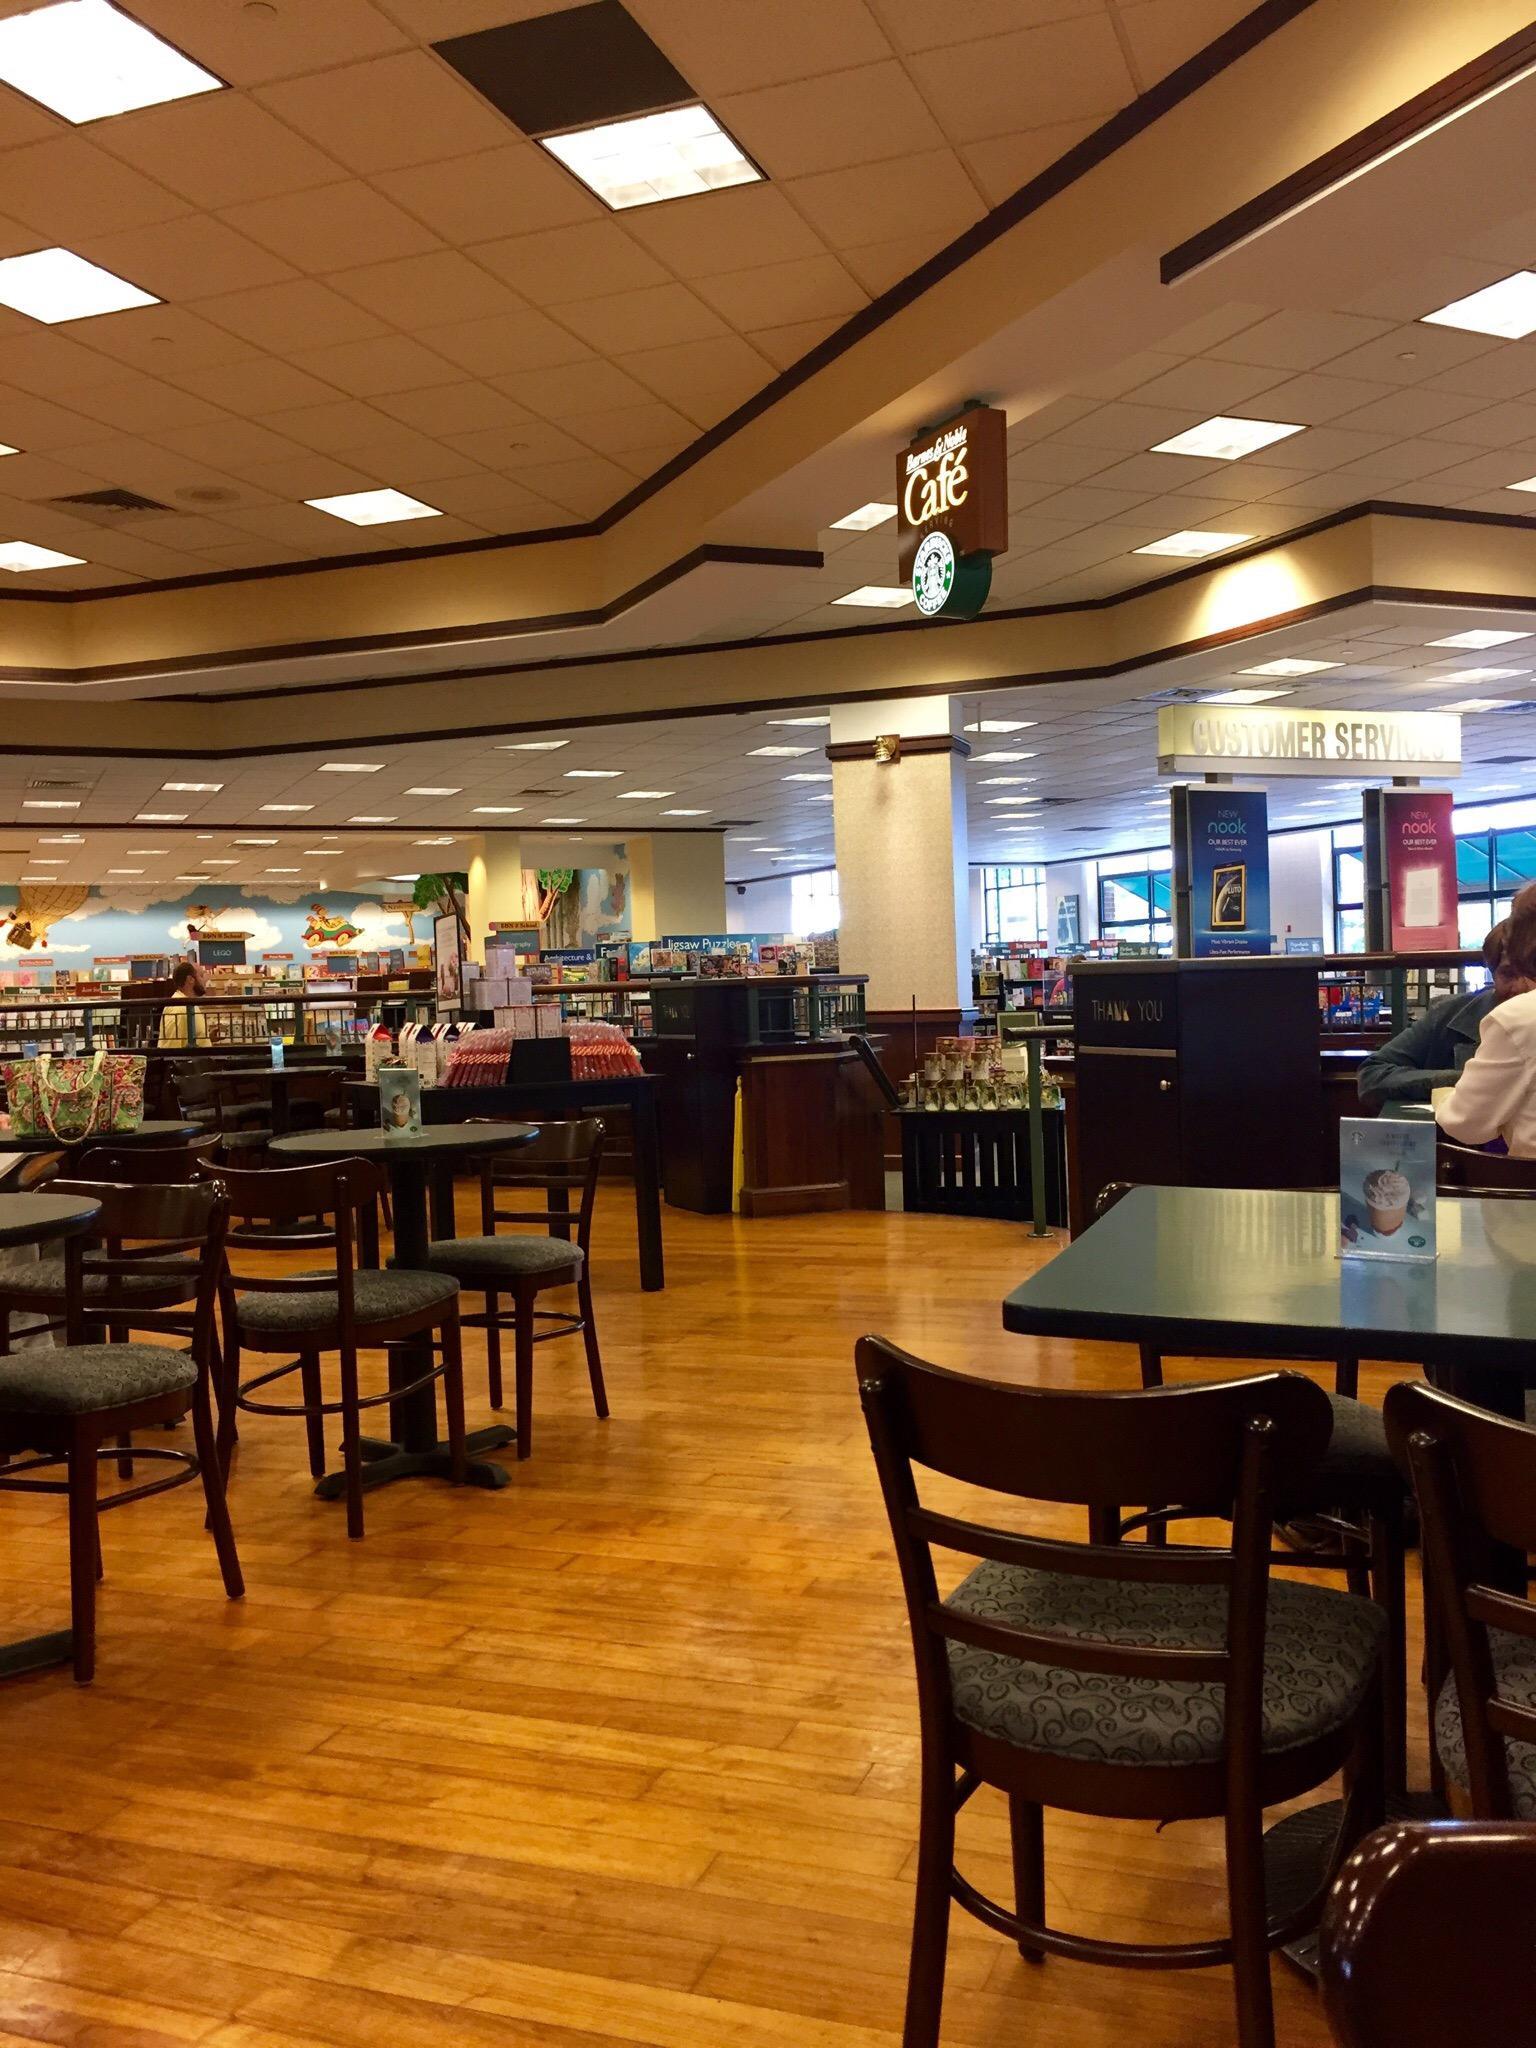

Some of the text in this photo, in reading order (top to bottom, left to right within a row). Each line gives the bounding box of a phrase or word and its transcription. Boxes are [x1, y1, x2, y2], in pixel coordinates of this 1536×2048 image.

[906, 425, 968, 473] Barnes & Noble
[904, 447, 970, 526] Café
[1192, 718, 1326, 759] CUSTOMER
[1217, 809, 1238, 818] NEW
[1410, 811, 1430, 820] NEW
[1207, 818, 1247, 834] nook
[1402, 818, 1437, 834] nook
[212, 949, 232, 957] LEGO
[667, 938, 741, 953] Jigsaw Puzzles
[586, 953, 593, 961] &
[1092, 1000, 1164, 1021] THANK YOU
